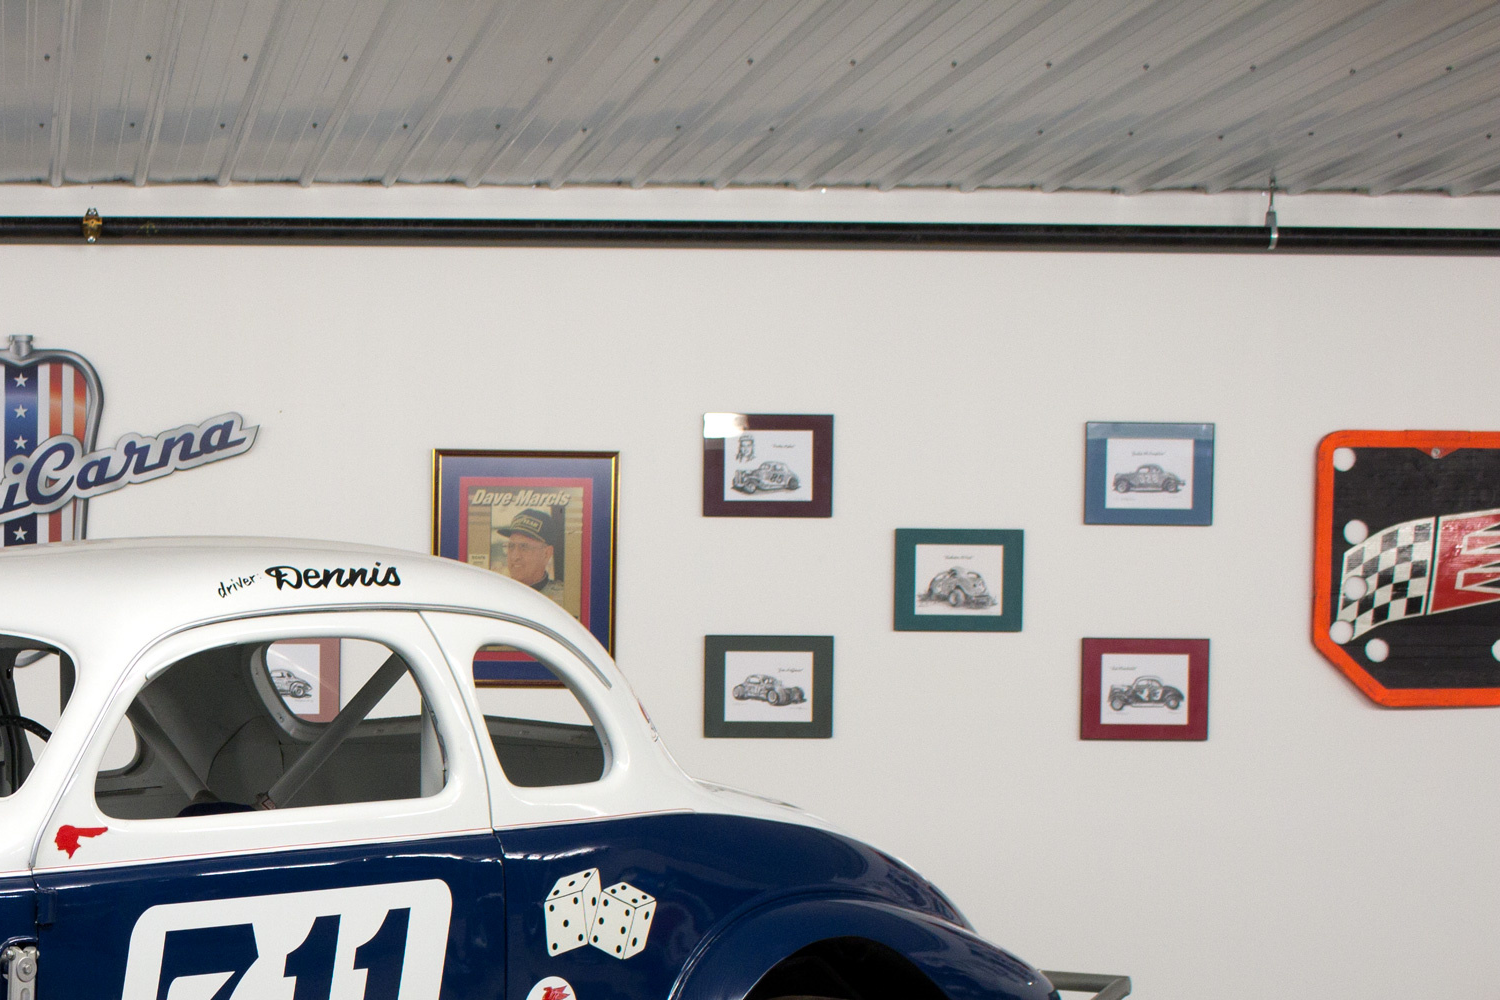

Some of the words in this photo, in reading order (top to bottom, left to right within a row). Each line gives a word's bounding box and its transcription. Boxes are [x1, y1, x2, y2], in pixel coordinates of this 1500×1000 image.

[471, 489, 513, 506] Dave
[515, 489, 571, 507] Marcis
[265, 562, 401, 590] Dennis
